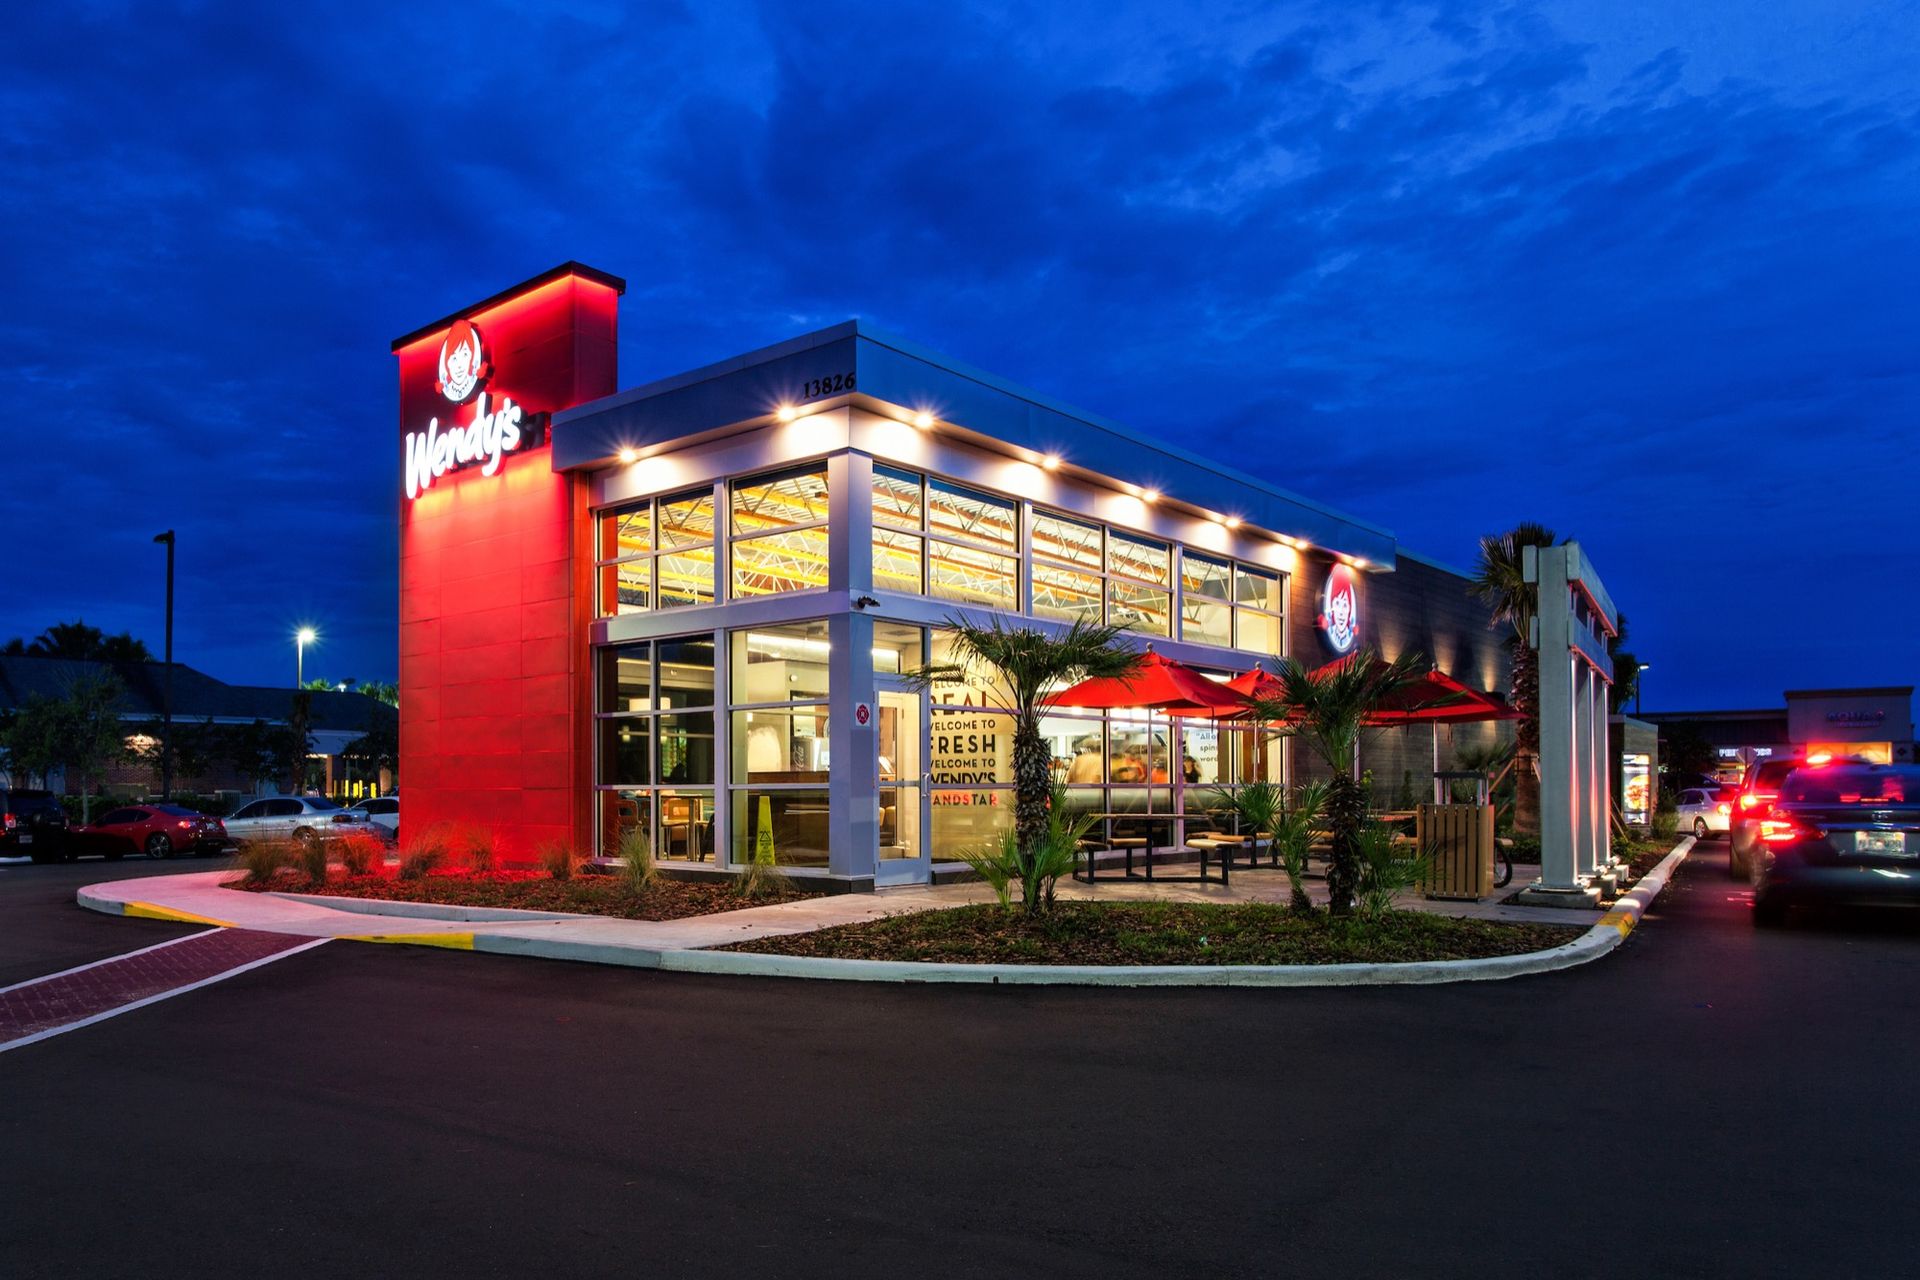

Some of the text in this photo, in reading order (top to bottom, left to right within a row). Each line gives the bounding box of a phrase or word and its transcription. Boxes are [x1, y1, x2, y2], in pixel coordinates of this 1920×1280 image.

[804, 372, 856, 400] 13826
[405, 391, 522, 499] Wendy's
[934, 675, 995, 689] ELCOME TO
[931, 719, 996, 731] ELCOME TO
[931, 758, 996, 769] ELCOME TO
